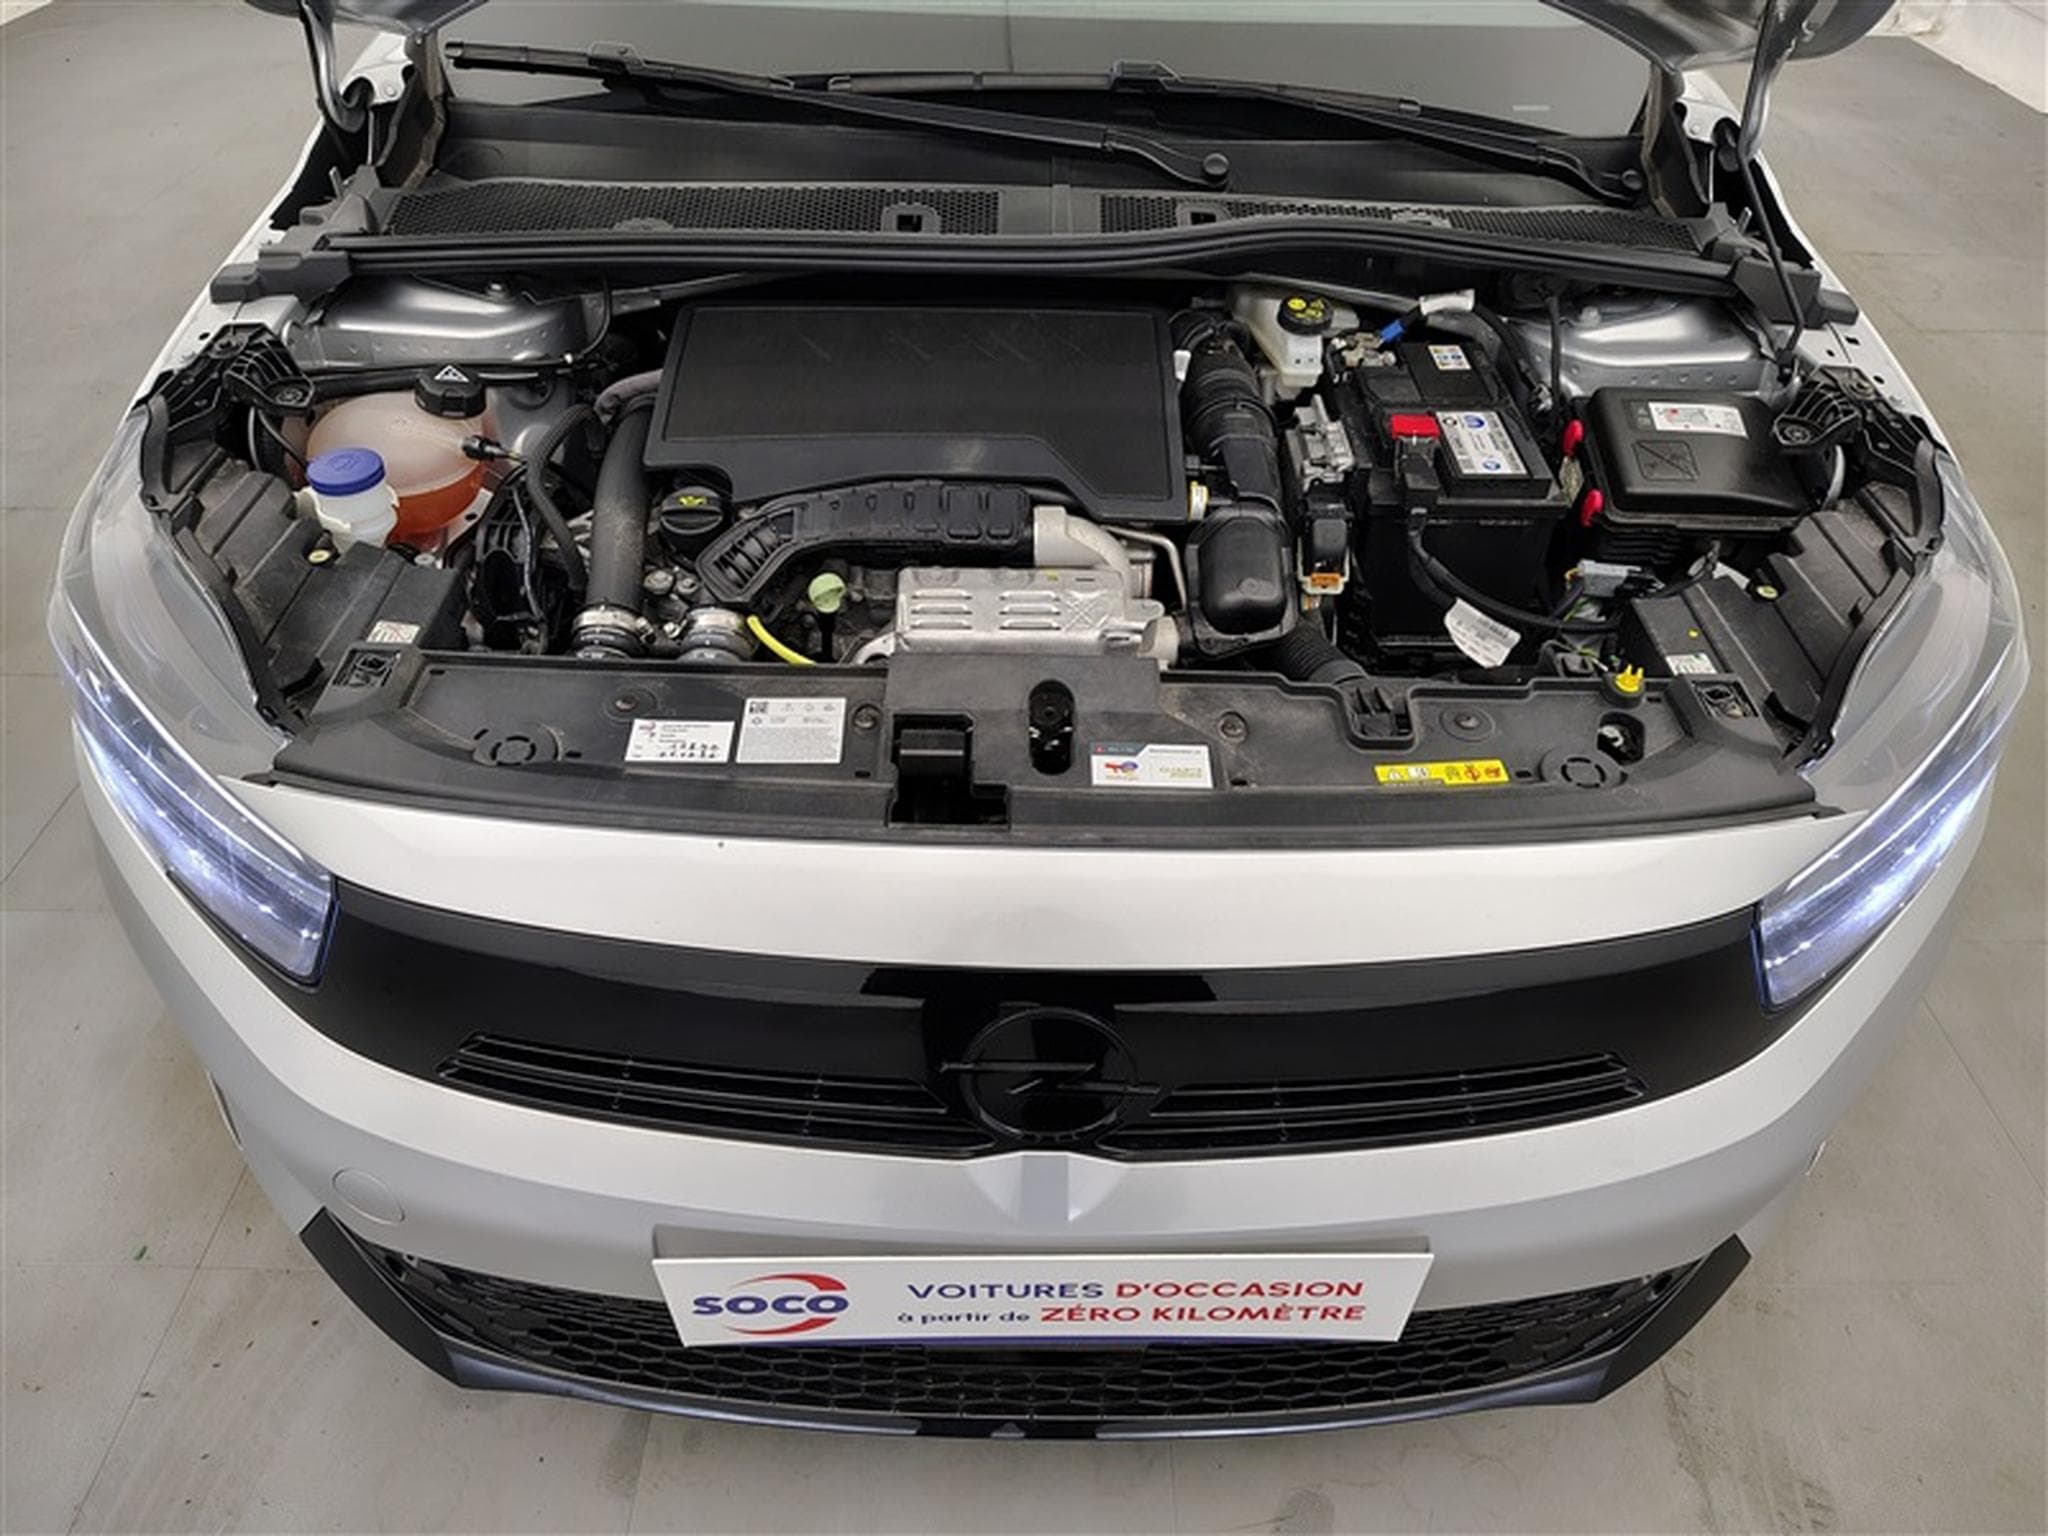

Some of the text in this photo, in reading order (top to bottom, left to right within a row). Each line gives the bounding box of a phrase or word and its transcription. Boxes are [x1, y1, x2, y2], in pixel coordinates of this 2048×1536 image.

[906, 1281, 1364, 1300] VOITURES D'OCCASION
[691, 1294, 850, 1316] SOCO
[920, 1309, 992, 1325] partir
[999, 1309, 1031, 1323] de
[1040, 1303, 1141, 1323] ZÉRO
[1151, 1302, 1367, 1321] KILOMÈTRE
